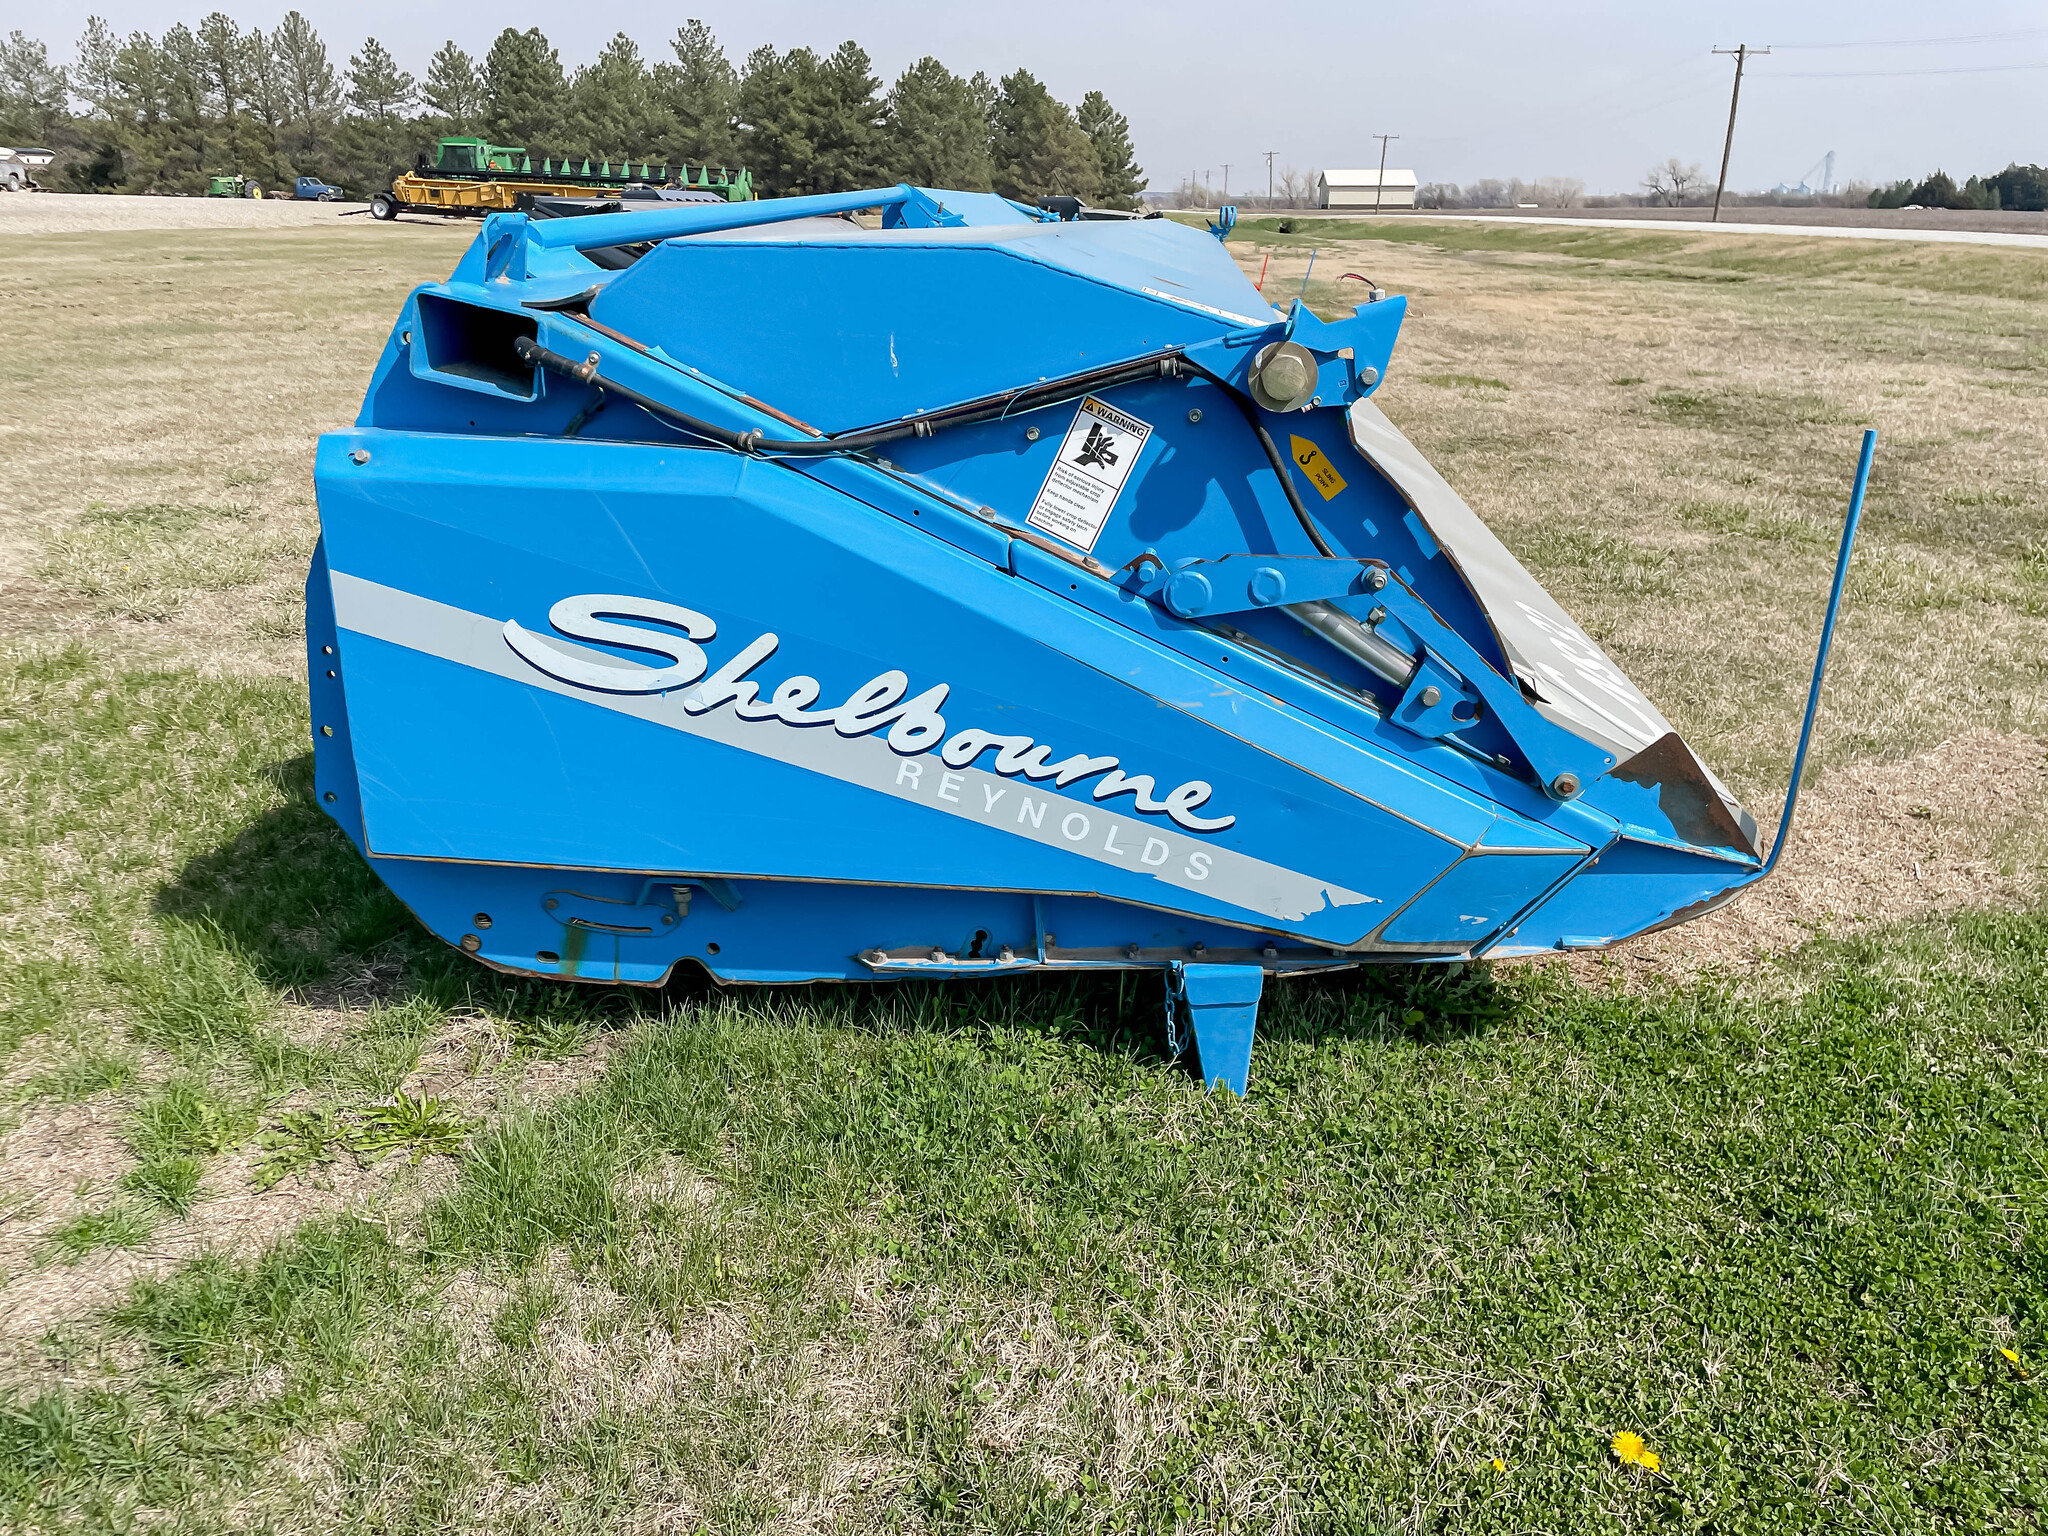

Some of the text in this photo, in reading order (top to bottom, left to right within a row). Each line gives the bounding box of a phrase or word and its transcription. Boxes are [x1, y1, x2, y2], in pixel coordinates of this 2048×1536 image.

[1097, 407, 1145, 437] WARNING
[1315, 473, 1329, 489] POINT
[1322, 468, 1336, 484] SLING
[502, 594, 1236, 833] Shelbourne
[895, 759, 1213, 882] REYNOLDS
